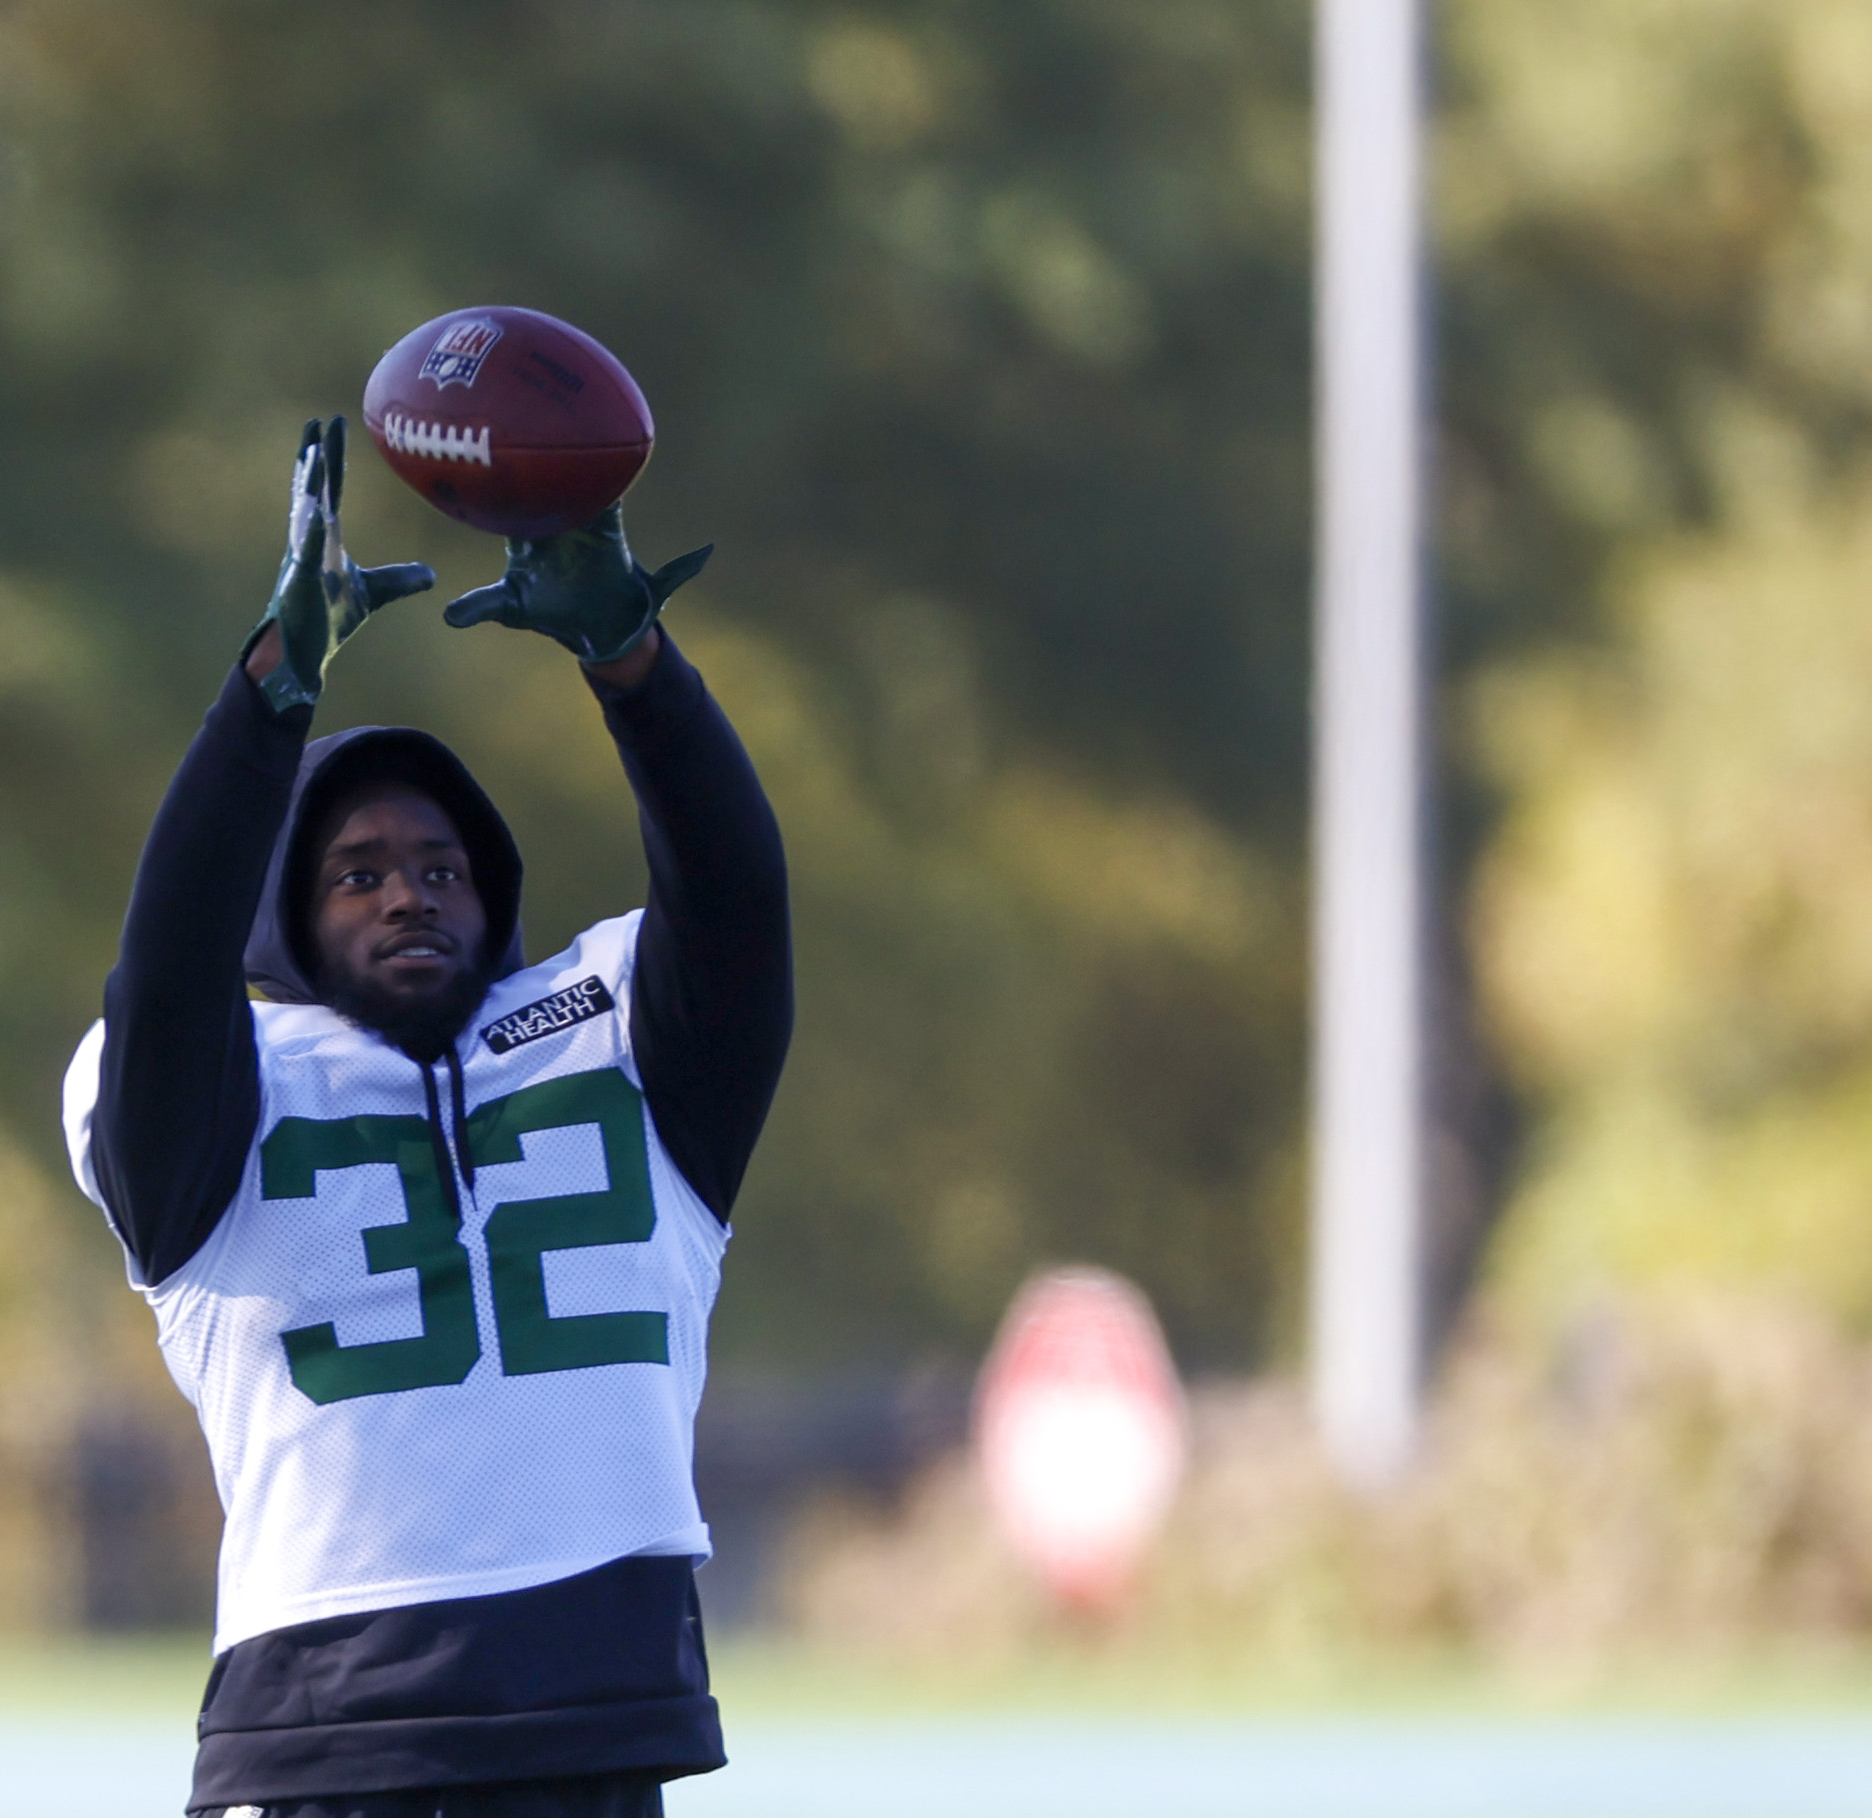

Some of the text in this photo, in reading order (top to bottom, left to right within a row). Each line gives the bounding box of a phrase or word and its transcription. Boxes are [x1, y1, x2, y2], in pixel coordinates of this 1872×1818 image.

[487, 980, 600, 1040] ATLANTIC
[504, 997, 596, 1044] HEALTH
[260, 1066, 670, 1406] 32
